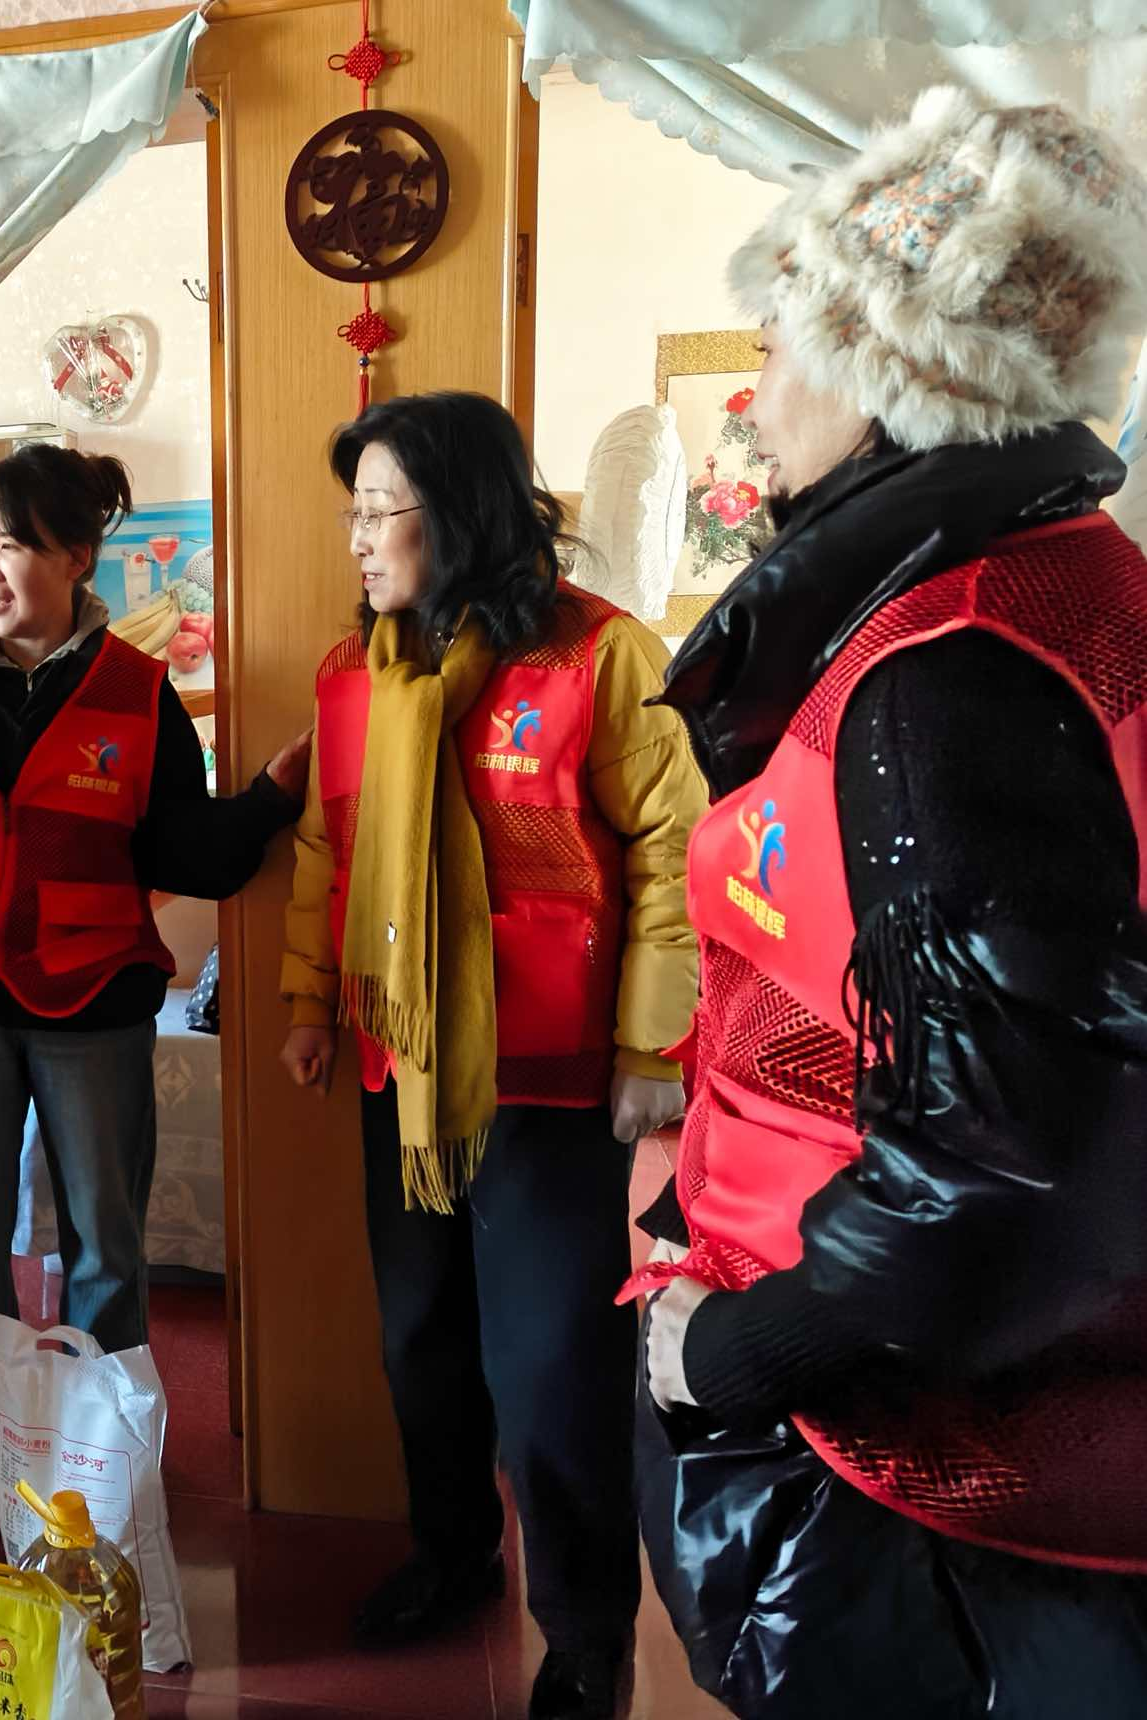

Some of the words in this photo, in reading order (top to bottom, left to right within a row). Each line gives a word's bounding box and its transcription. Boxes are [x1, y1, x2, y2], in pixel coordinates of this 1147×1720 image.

[475, 753, 541, 775] 柏林银辉
[61, 1450, 106, 1472] 金沙河
